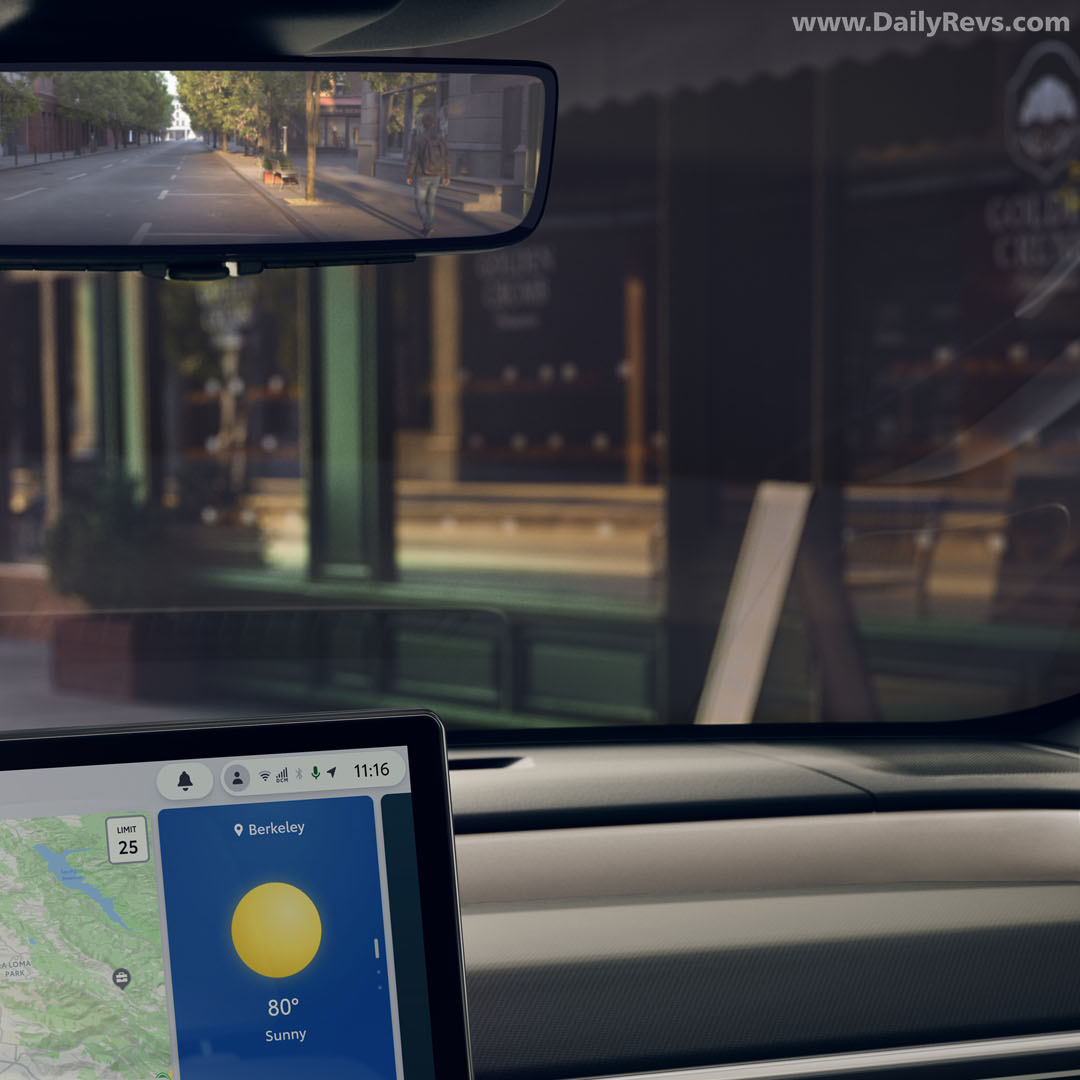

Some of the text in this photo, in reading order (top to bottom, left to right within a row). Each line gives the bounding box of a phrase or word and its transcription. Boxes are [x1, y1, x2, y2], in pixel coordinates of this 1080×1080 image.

[354, 762, 390, 778] 11:16
[116, 825, 137, 834] LIMIT
[248, 821, 305, 836] Berkeley
[118, 840, 138, 855] 25
[265, 1030, 306, 1042] Sunny
